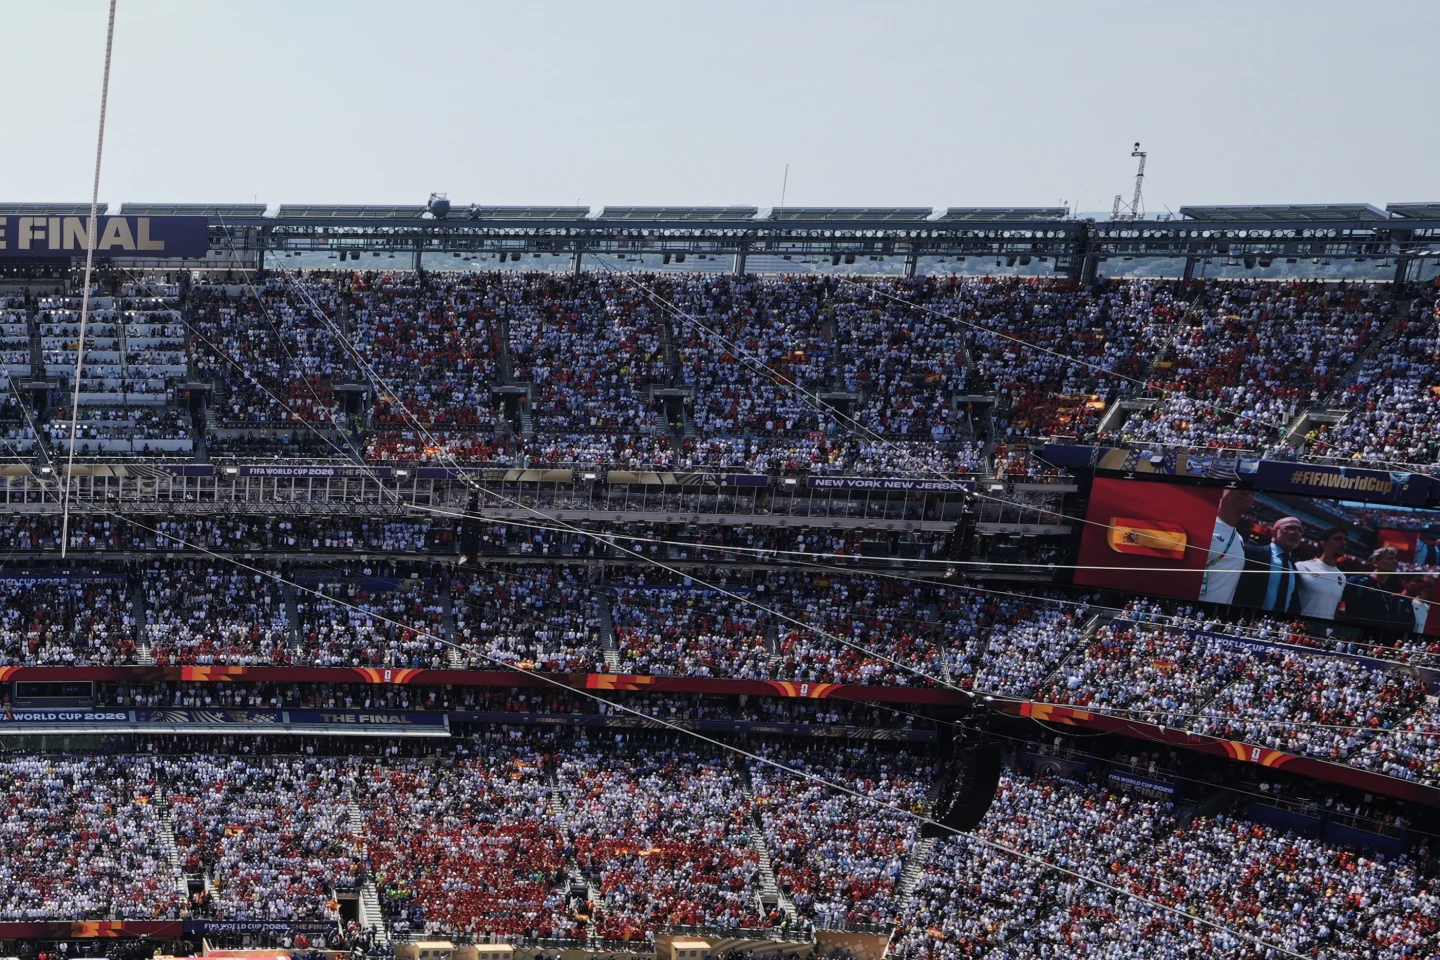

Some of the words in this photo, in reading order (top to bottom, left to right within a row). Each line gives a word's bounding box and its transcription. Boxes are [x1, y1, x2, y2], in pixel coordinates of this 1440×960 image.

[18, 216, 165, 250] FINAL
[815, 479, 843, 487] NEW
[847, 480, 882, 488] YORK
[884, 481, 913, 489] NEW
[915, 482, 967, 490] JERSEY
[1290, 470, 1393, 495] #FIFAWorldCup
[84, 712, 127, 720] 2026
[320, 713, 356, 723] THE
[359, 714, 412, 724] FINAL
